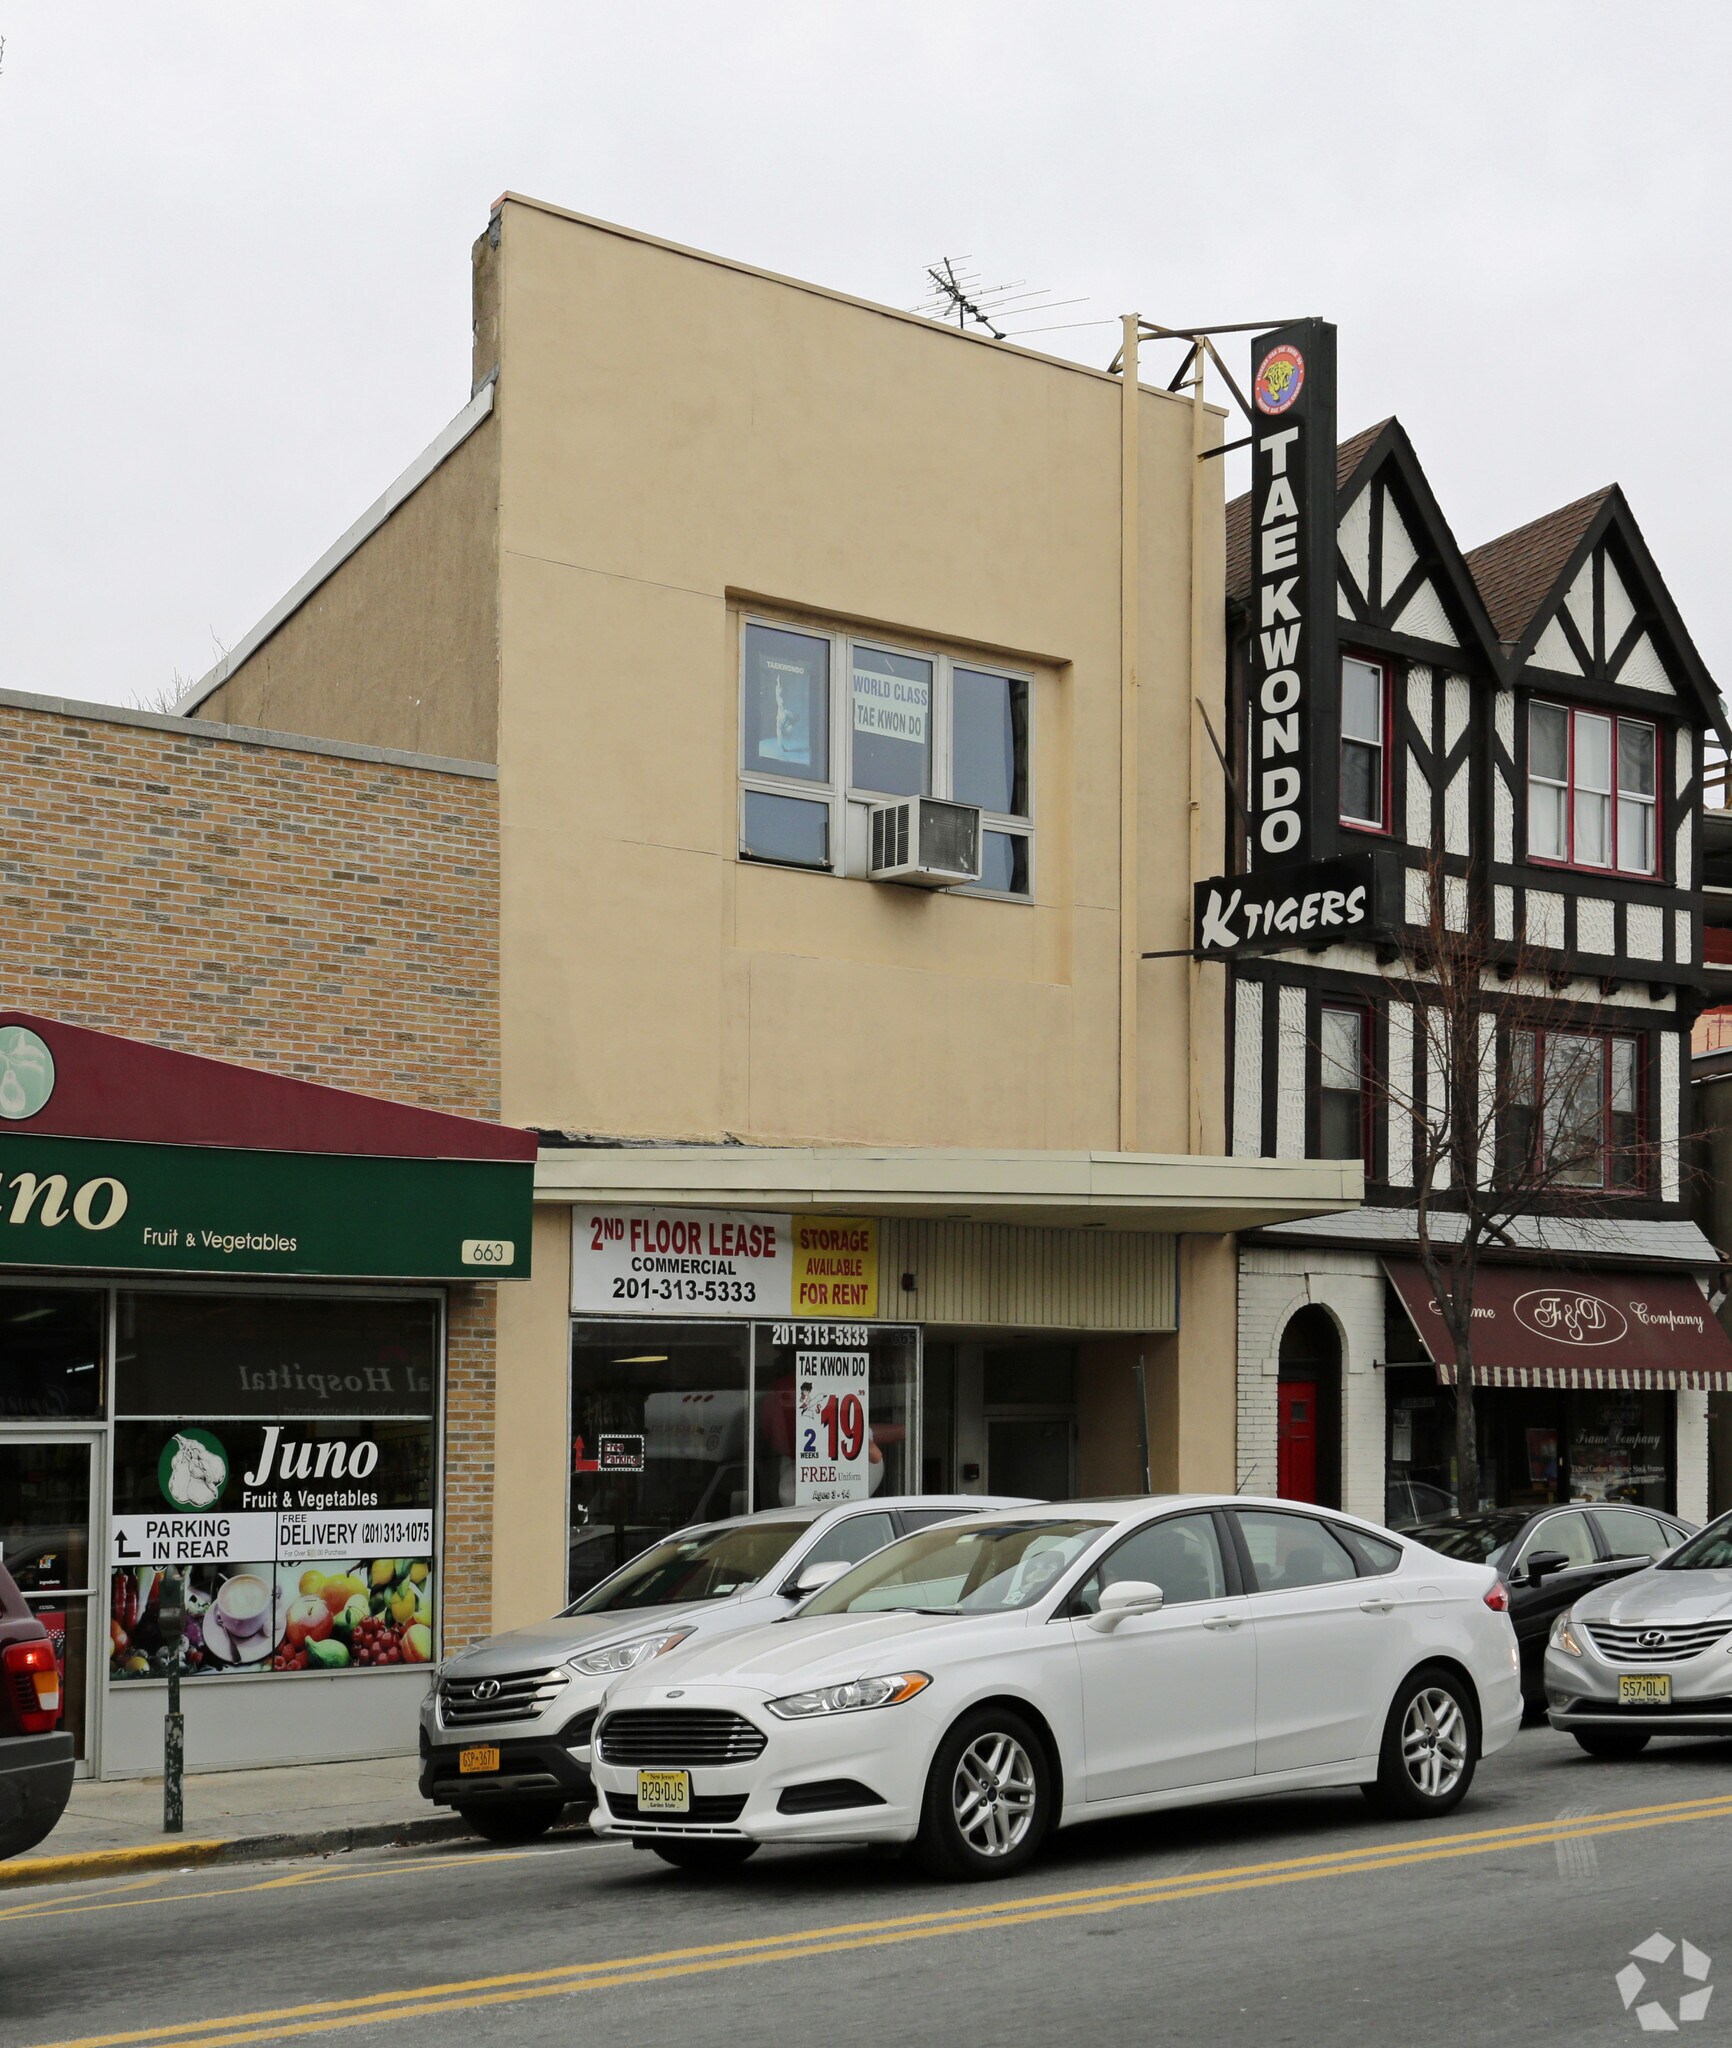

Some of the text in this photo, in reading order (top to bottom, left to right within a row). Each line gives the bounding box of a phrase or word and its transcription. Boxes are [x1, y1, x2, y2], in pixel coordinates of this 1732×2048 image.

[766, 661, 805, 674] TAEKWONDO
[853, 675, 928, 706] WORLD CLASS
[857, 705, 922, 736] TAE KWON DO
[0, 1172, 128, 1230] no
[143, 1228, 297, 1253] Fruit & Vegetables
[590, 1217, 776, 1258] 2ND FLOOR LEASE
[800, 1227, 869, 1252] STORAGE
[473, 1244, 503, 1262] 663
[631, 1257, 737, 1276] COMMERCIAL
[806, 1258, 863, 1276] AVAILABLE
[612, 1277, 757, 1302] 201-313-5333
[799, 1282, 869, 1305] FOR RENT
[1629, 1302, 1704, 1334] Company
[772, 1324, 869, 1346] 201-313-5333
[799, 1356, 866, 1377] TAE KWON DO
[604, 1442, 625, 1452] Free
[803, 1428, 816, 1452] 2
[1576, 1428, 1661, 1450] Frame Company
[243, 1426, 379, 1487] Juno
[800, 1466, 861, 1482] FREE Uniform
[242, 1490, 378, 1511] Fruit & Vegetables
[146, 1519, 230, 1539] PARKING
[282, 1514, 307, 1523] FREE
[280, 1523, 358, 1546] DELIVERY
[153, 1540, 229, 1559] IN REAR
